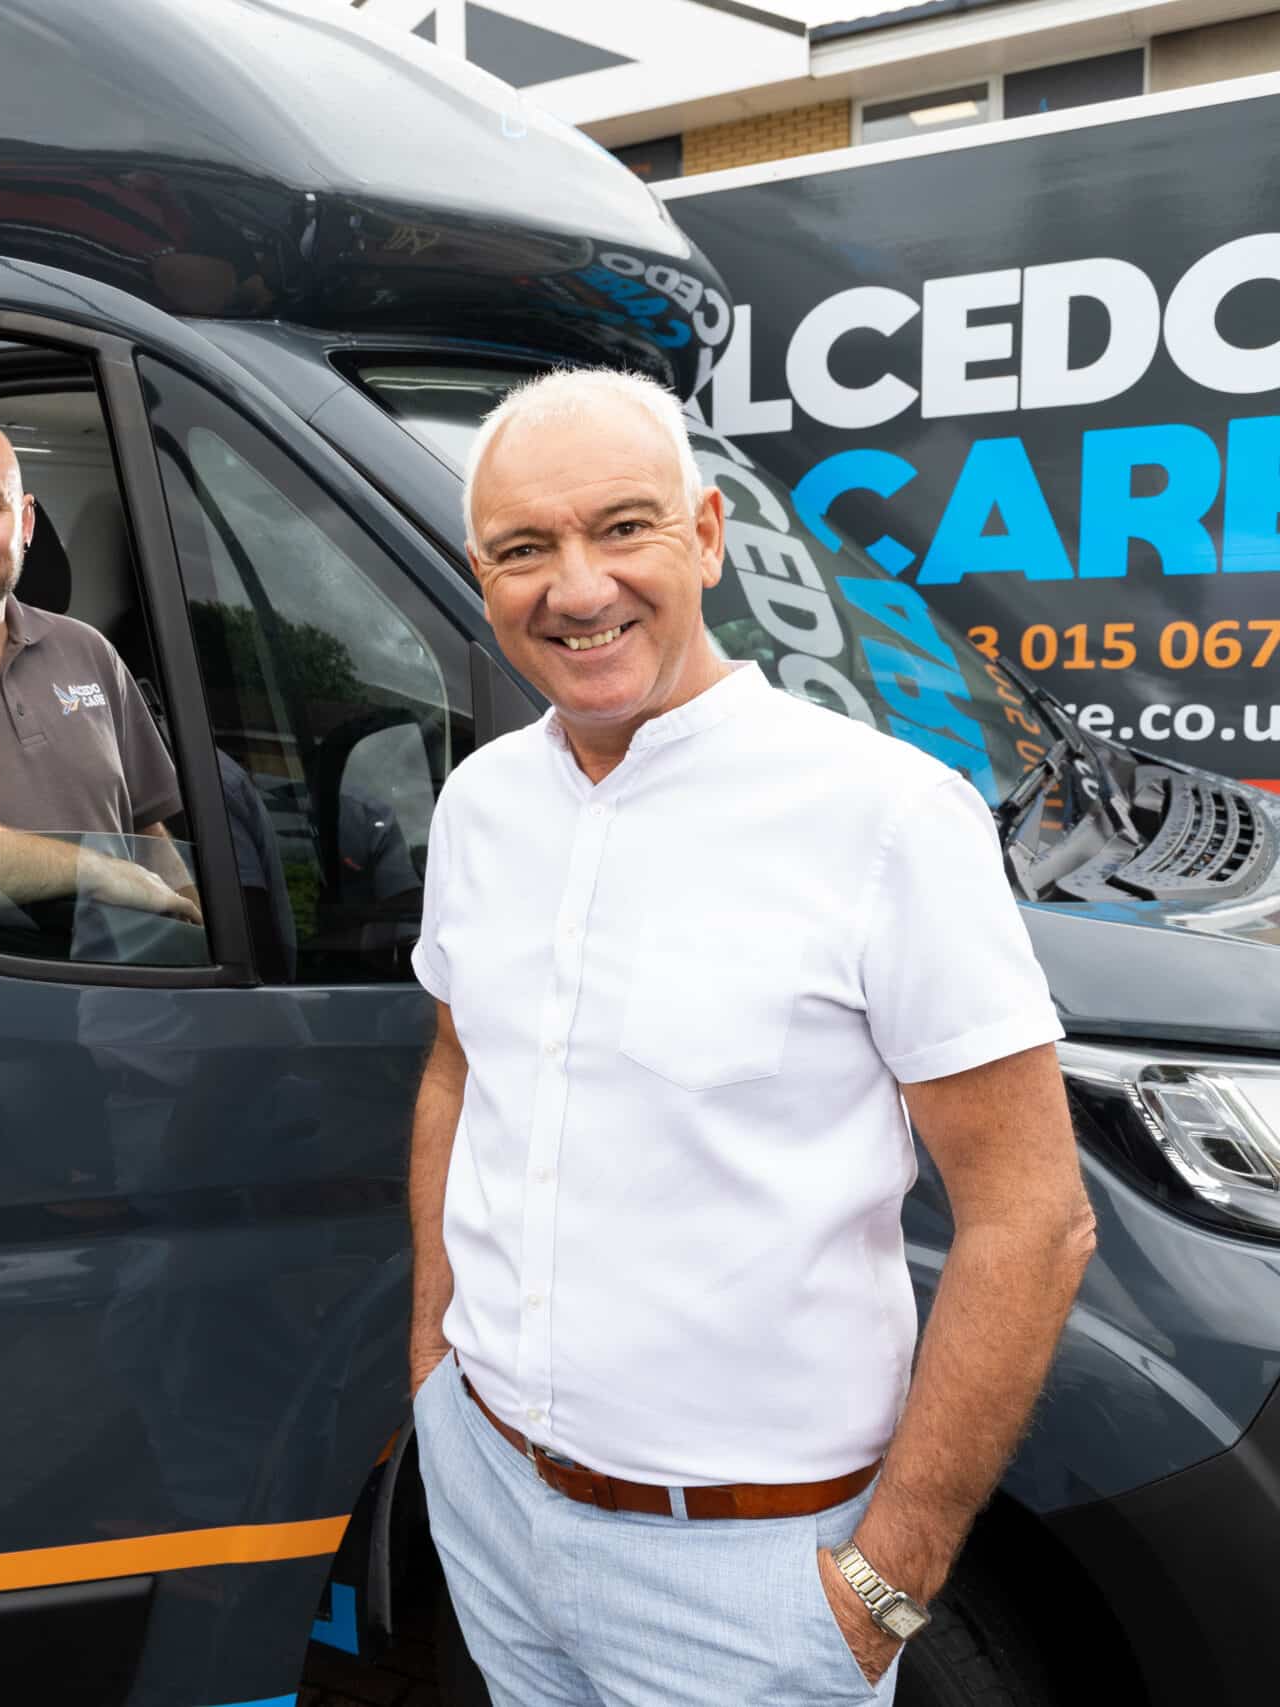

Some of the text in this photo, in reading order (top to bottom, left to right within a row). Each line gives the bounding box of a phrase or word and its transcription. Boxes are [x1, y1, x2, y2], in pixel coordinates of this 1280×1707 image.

[686, 233, 1280, 436] LCEDO
[1020, 623, 1137, 670] 015
[1065, 703, 1280, 742] e.co.u
